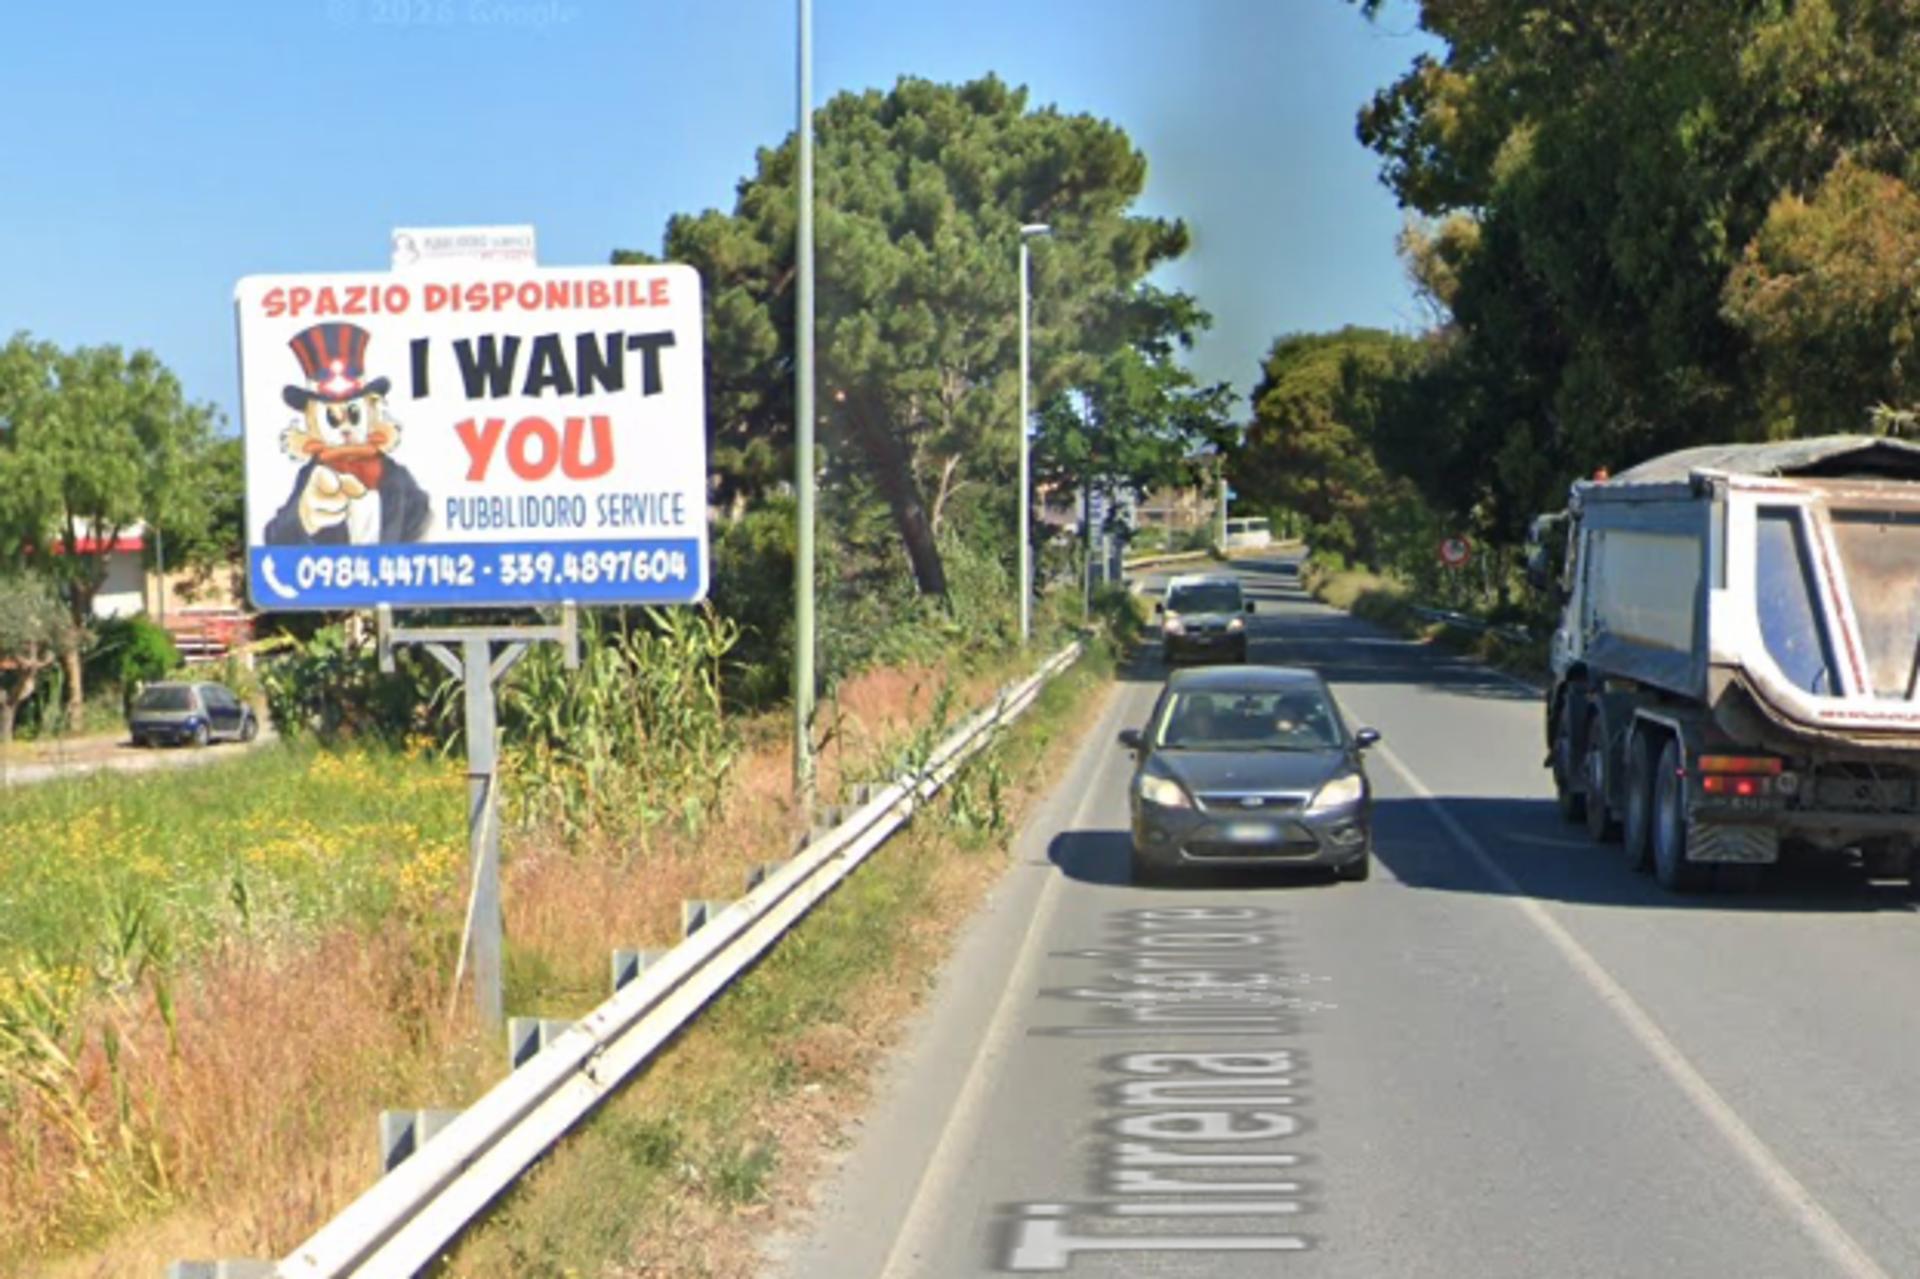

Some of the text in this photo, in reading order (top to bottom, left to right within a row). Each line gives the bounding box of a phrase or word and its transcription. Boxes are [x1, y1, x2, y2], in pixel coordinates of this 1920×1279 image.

[261, 277, 670, 318] SPAZIO DISPONIBILE
[408, 329, 677, 401] I WANT
[453, 414, 616, 482] YOU
[446, 492, 686, 531] PUBBLIDORO SERVICE
[296, 554, 476, 589] 0984.447142
[500, 549, 688, 585] 339.4897604
